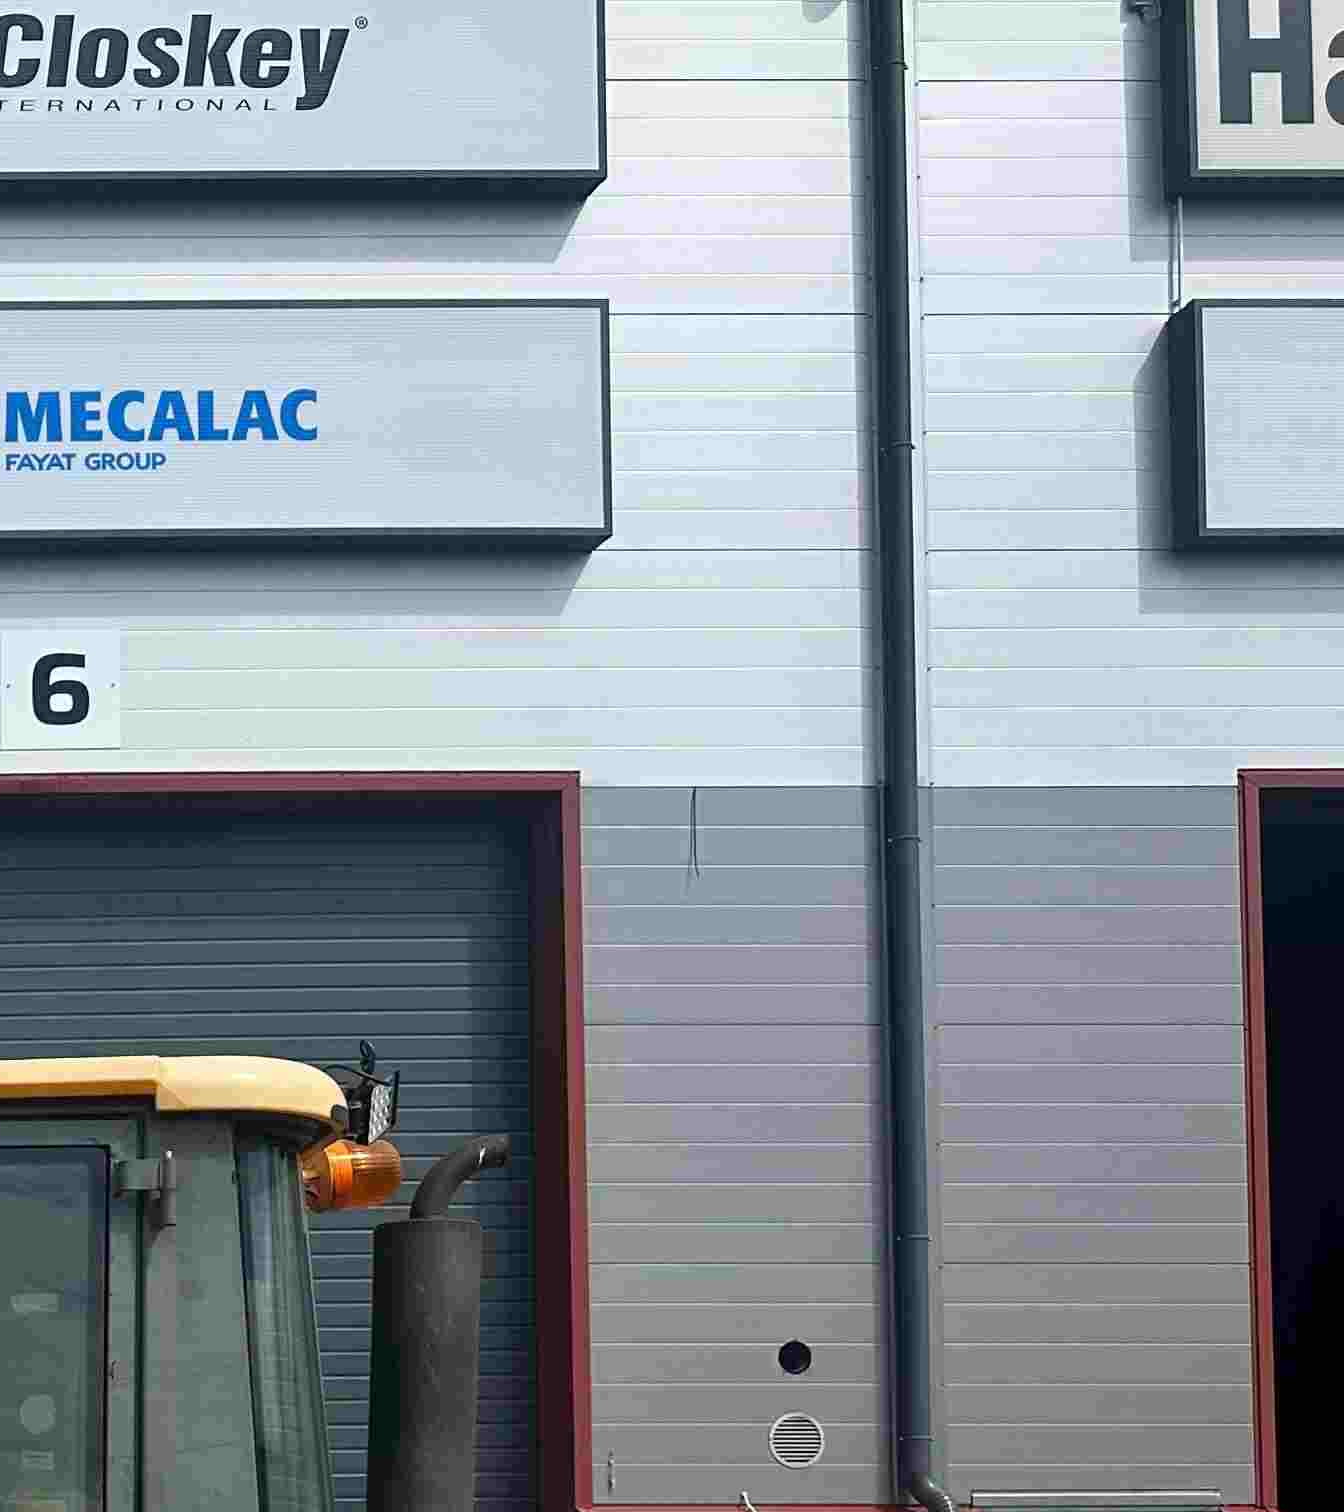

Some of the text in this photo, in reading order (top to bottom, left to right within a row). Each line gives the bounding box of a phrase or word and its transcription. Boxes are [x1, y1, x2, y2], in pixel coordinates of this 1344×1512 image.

[4, 388, 318, 443] MECALAC
[4, 453, 167, 472] FAYAT GROUP
[30, 652, 90, 725] 6
